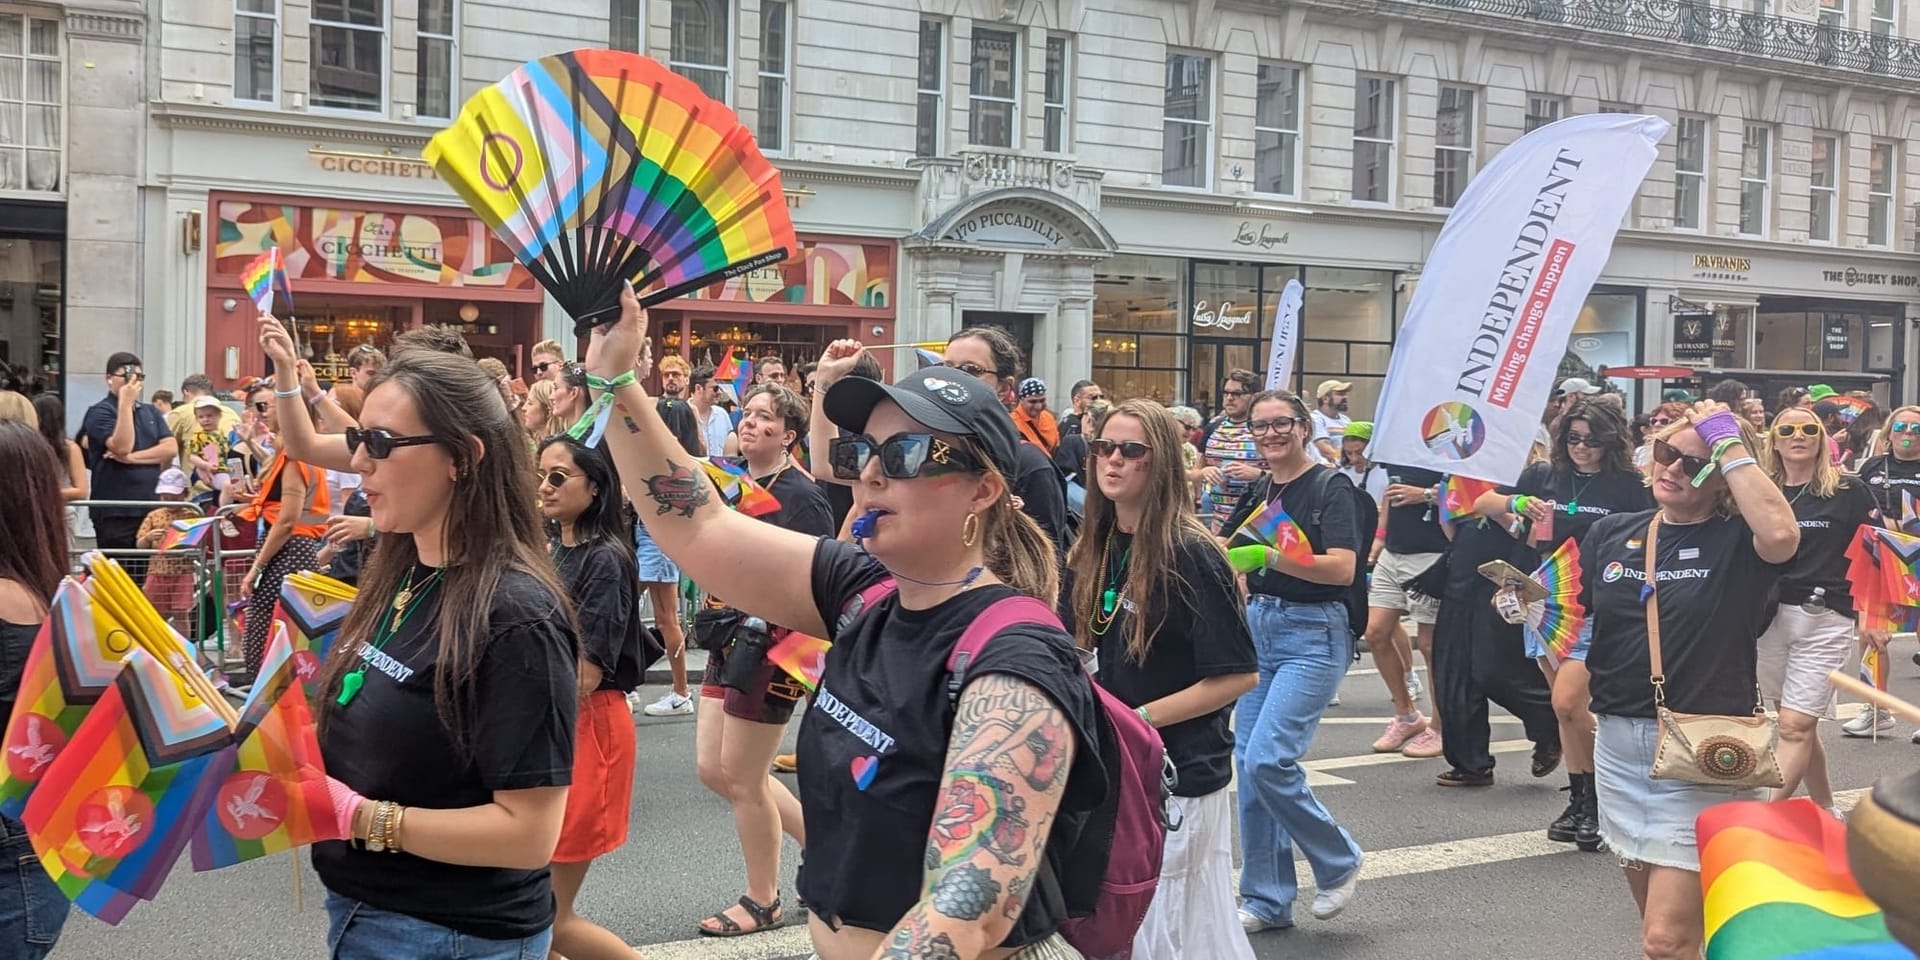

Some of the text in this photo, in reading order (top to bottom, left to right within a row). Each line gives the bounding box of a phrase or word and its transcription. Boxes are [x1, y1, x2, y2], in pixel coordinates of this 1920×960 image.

[321, 156, 438, 180] CICCHETT
[955, 212, 1064, 245] 170 PICCADILLY
[321, 241, 438, 261] CICCHETTI
[724, 269, 737, 278] The
[753, 258, 766, 267] Fan
[765, 252, 782, 262] Shop
[1456, 148, 1583, 398] INDEPENDENT
[1823, 270, 1843, 282] THE
[1845, 269, 1888, 286] WHISKY
[1492, 246, 1569, 403] Making change happen
[1624, 567, 1710, 582] INDPENDENT
